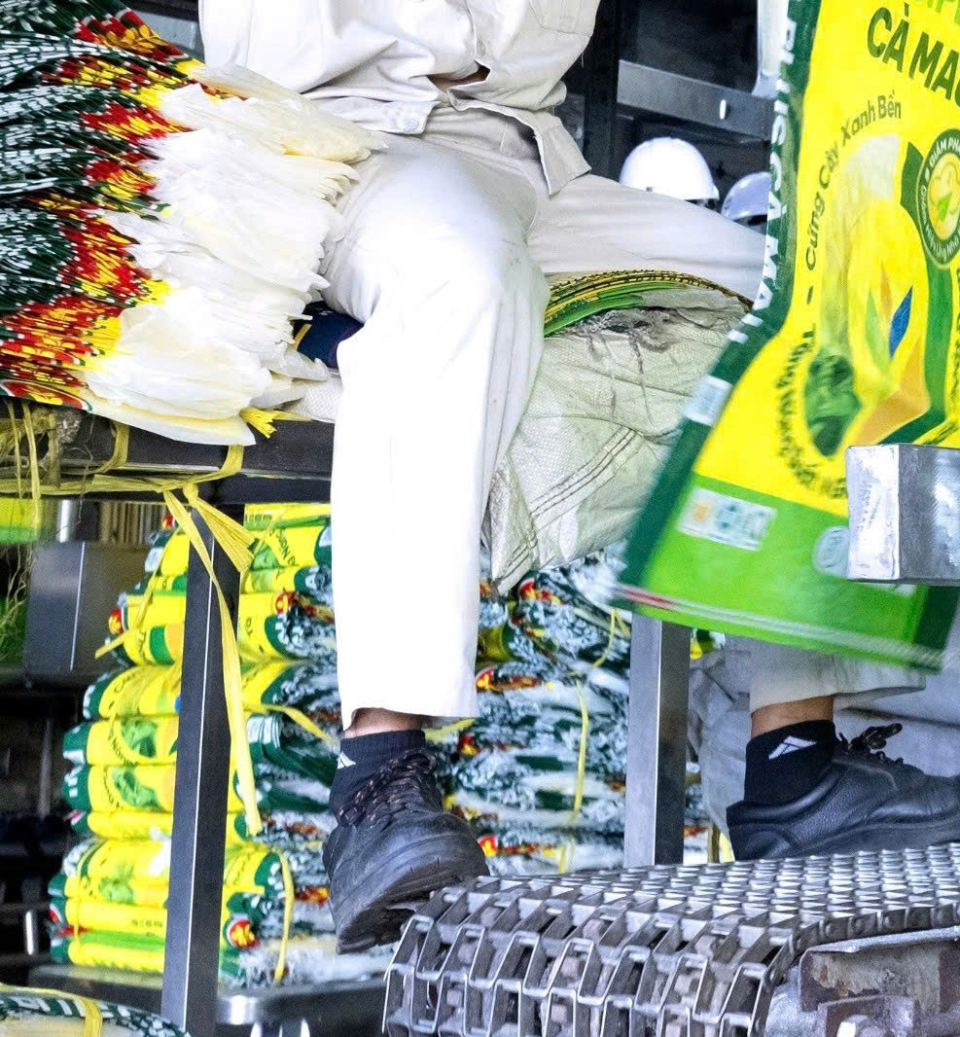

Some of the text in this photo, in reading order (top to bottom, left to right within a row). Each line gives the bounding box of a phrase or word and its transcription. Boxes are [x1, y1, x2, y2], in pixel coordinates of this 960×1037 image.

[867, 2, 911, 73] CÀ
[840, 100, 877, 144] Xanh
[877, 89, 902, 120] Bền
